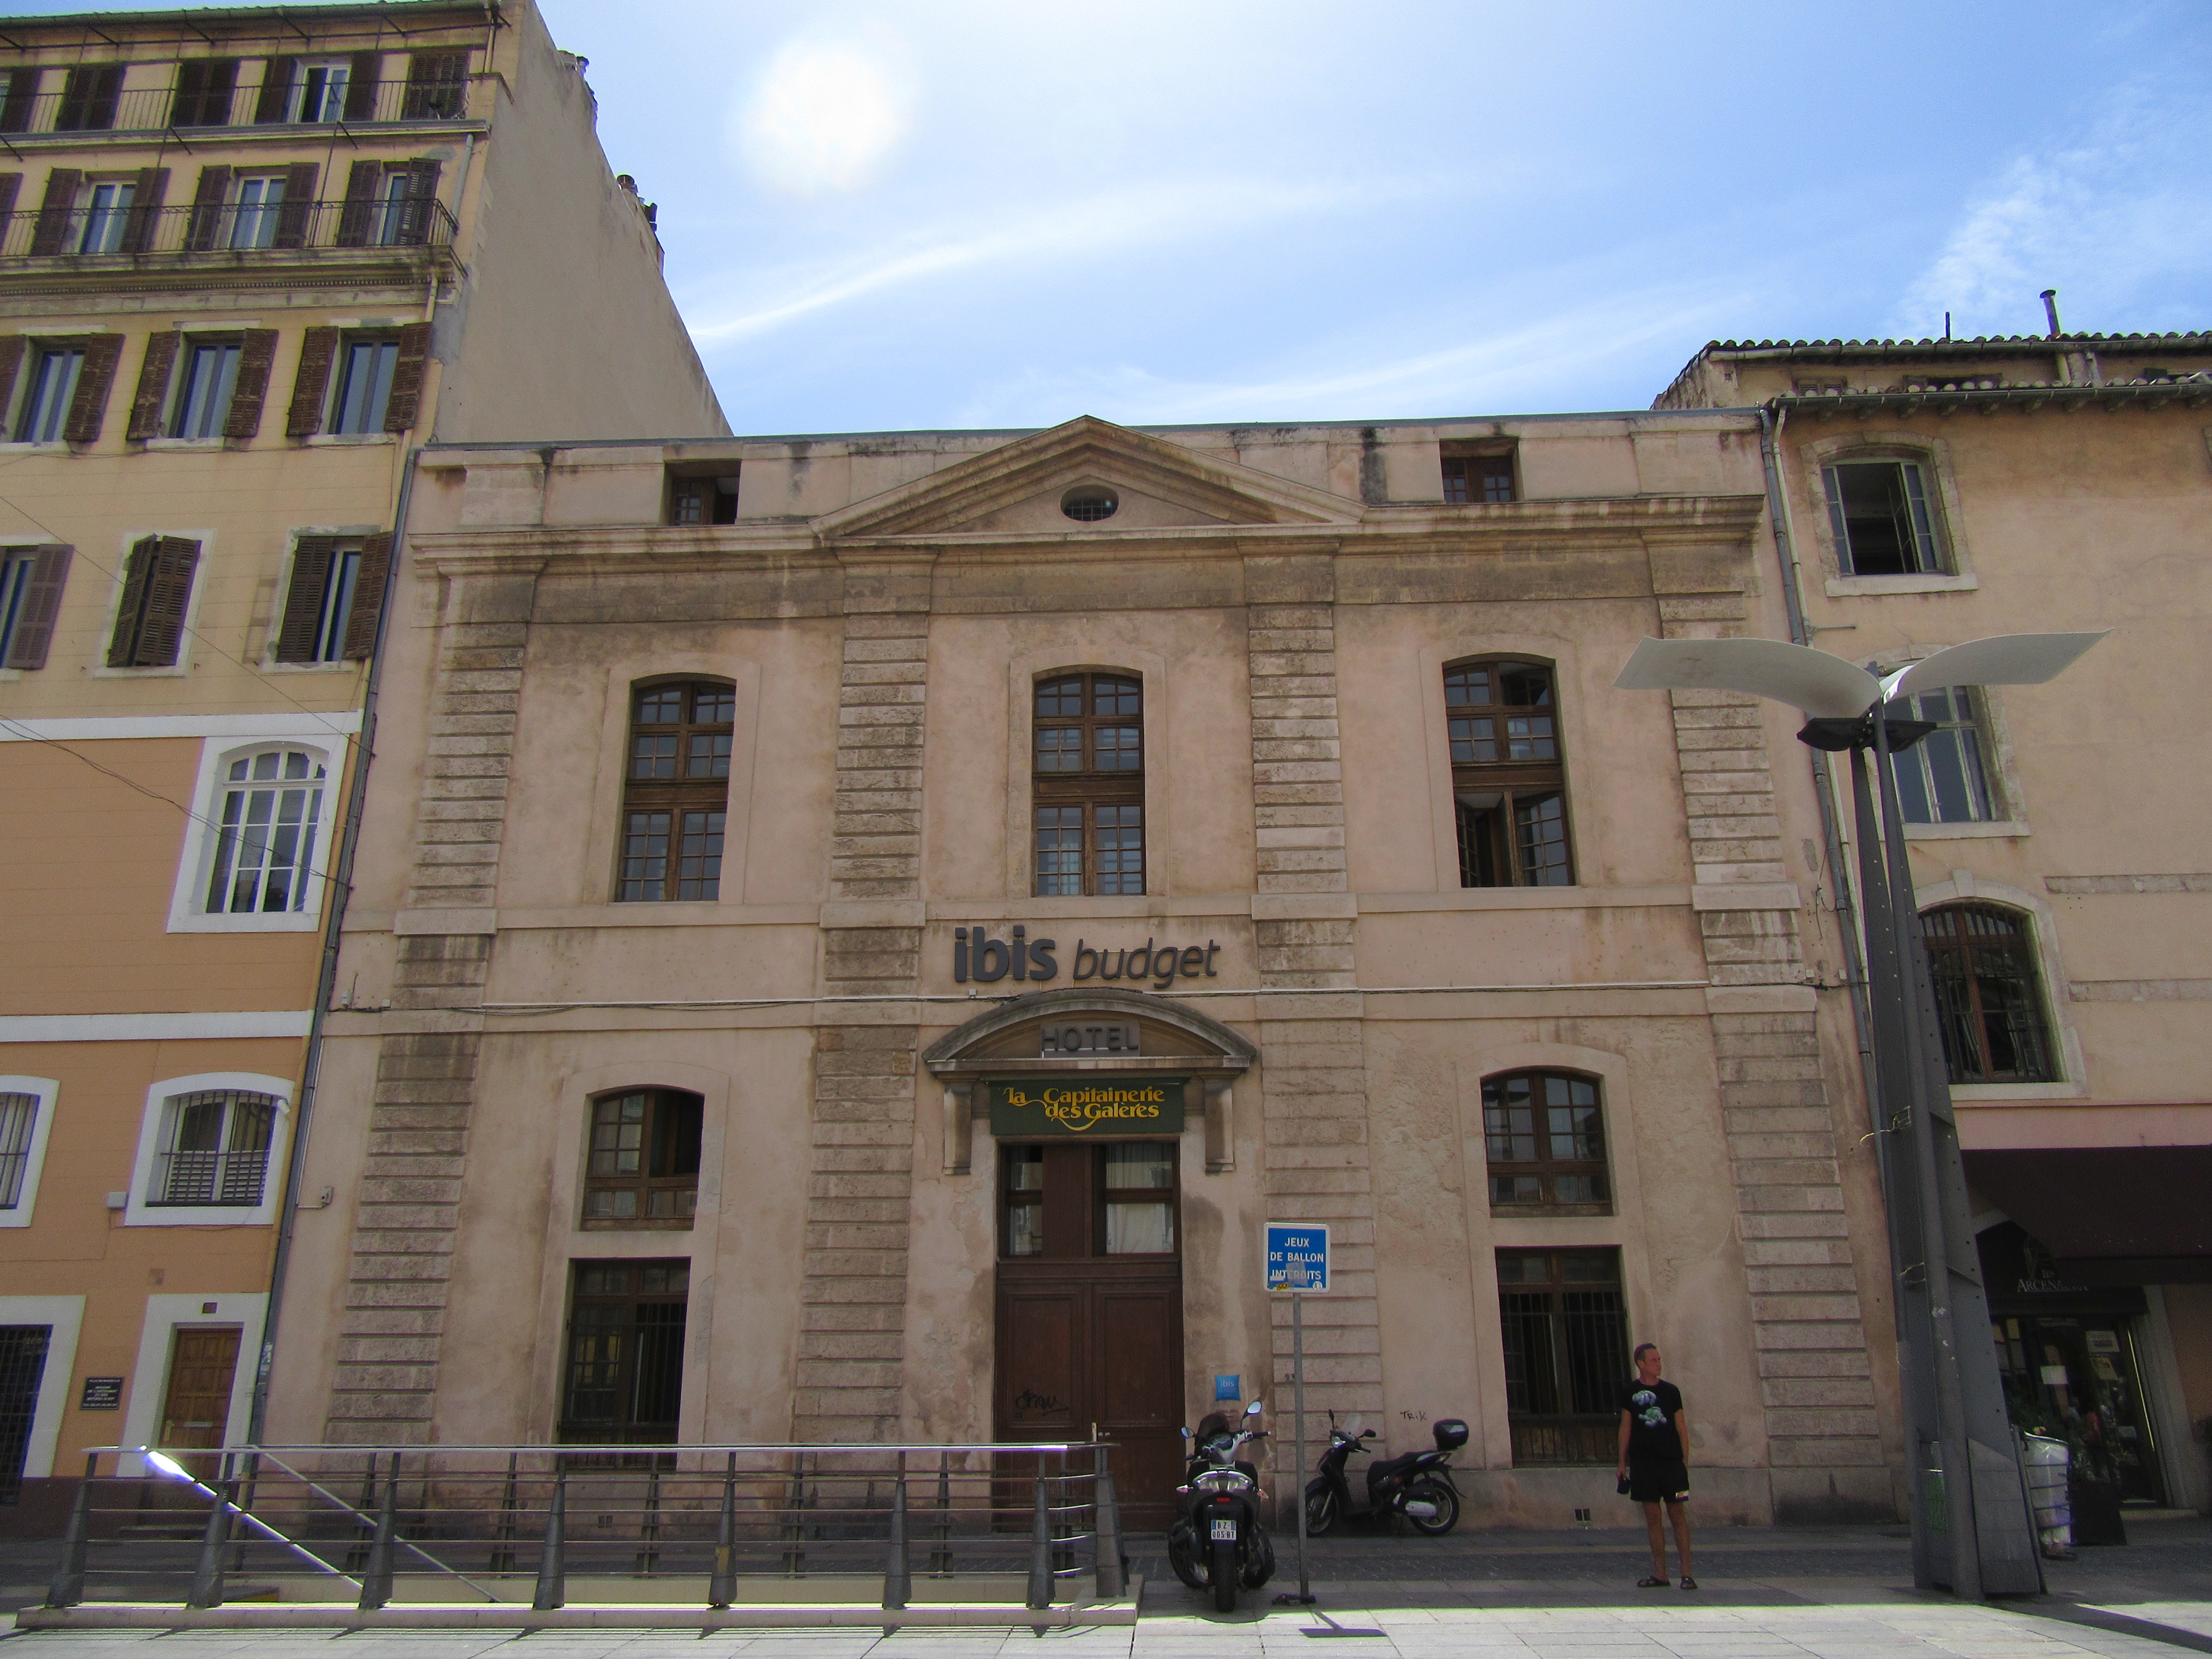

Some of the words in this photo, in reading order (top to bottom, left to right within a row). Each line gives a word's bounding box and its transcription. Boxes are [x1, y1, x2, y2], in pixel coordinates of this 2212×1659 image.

[954, 925, 1058, 983] ibis
[1073, 937, 1220, 988] budget
[1040, 1027, 1139, 1052] HOTEL
[1044, 1086, 1164, 1106] Capitainerie
[1045, 1102, 1082, 1119] des
[1084, 1102, 1160, 1119] Galères
[1284, 1237, 1310, 1247] JEUX
[1270, 1252, 1283, 1261] DE
[1287, 1253, 1324, 1262] BALLON
